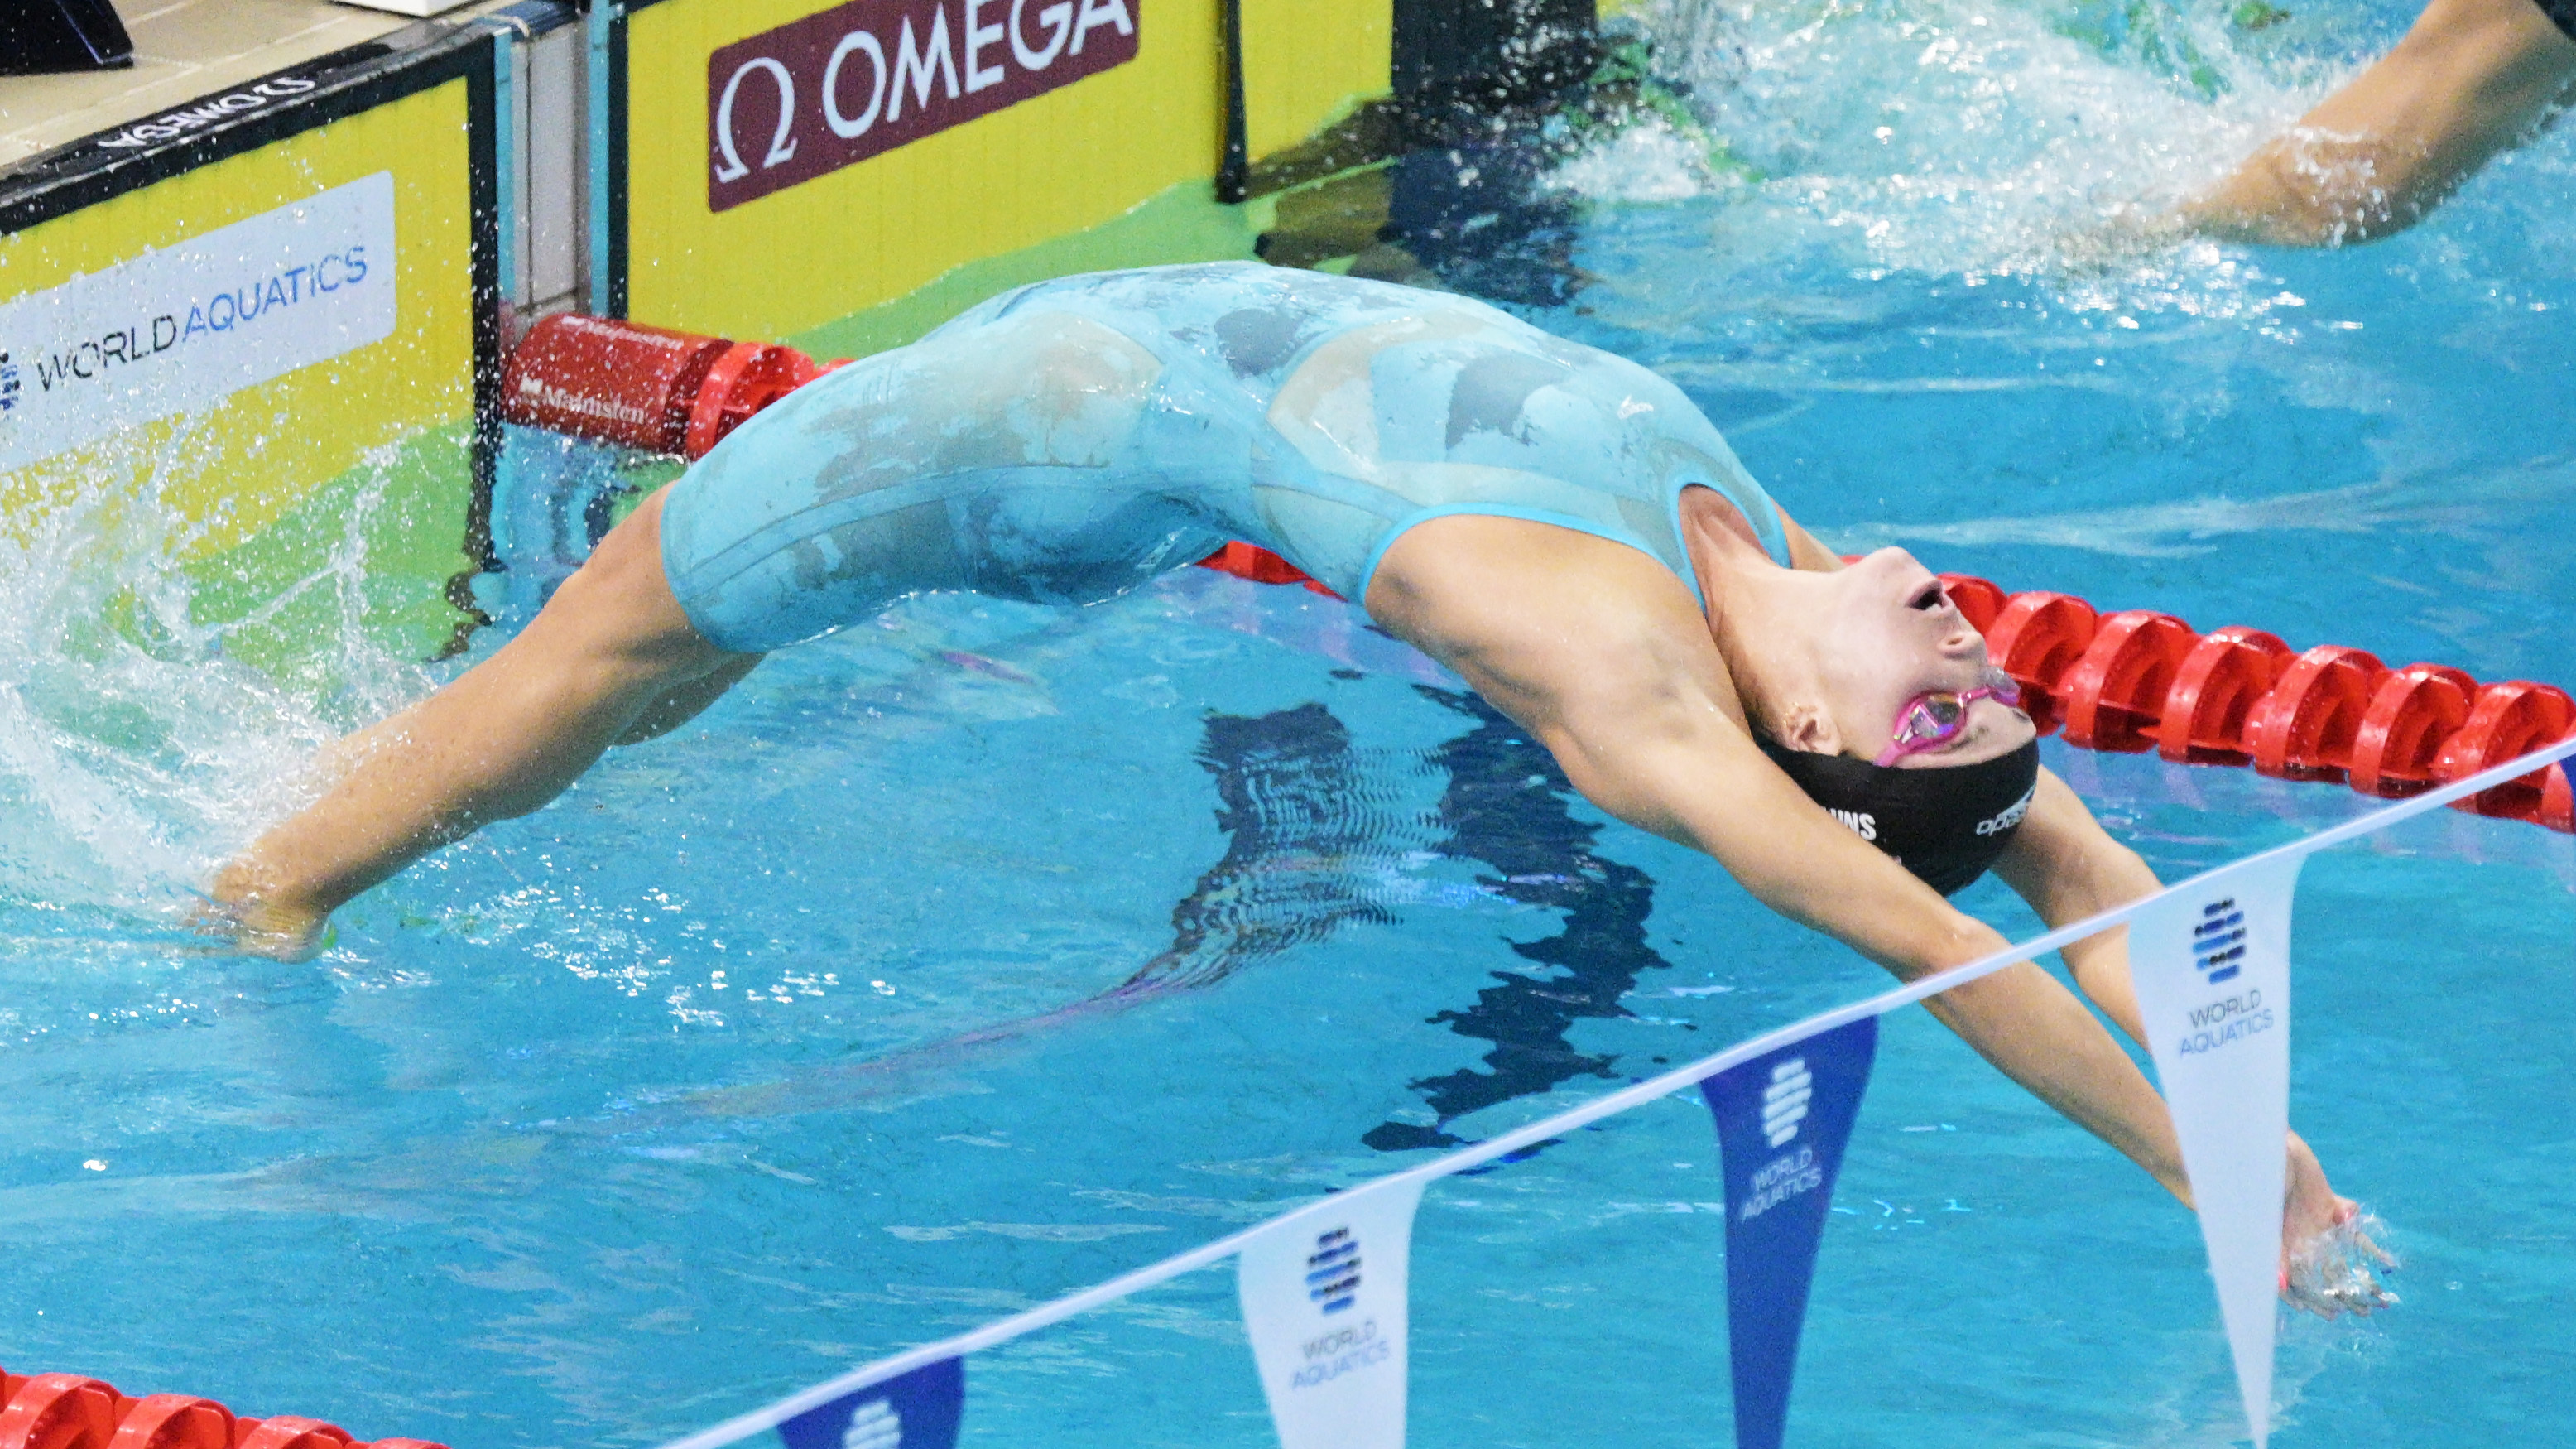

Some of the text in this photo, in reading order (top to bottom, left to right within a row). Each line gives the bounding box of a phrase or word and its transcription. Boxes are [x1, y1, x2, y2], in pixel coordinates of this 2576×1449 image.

[822, 0, 1134, 139] OMEGA
[2189, 989, 2261, 1029] WORLD
[2180, 1008, 2274, 1058] AQUATICS
[1752, 1148, 1813, 1191] WORLD
[1303, 1321, 1377, 1359] WORLD
